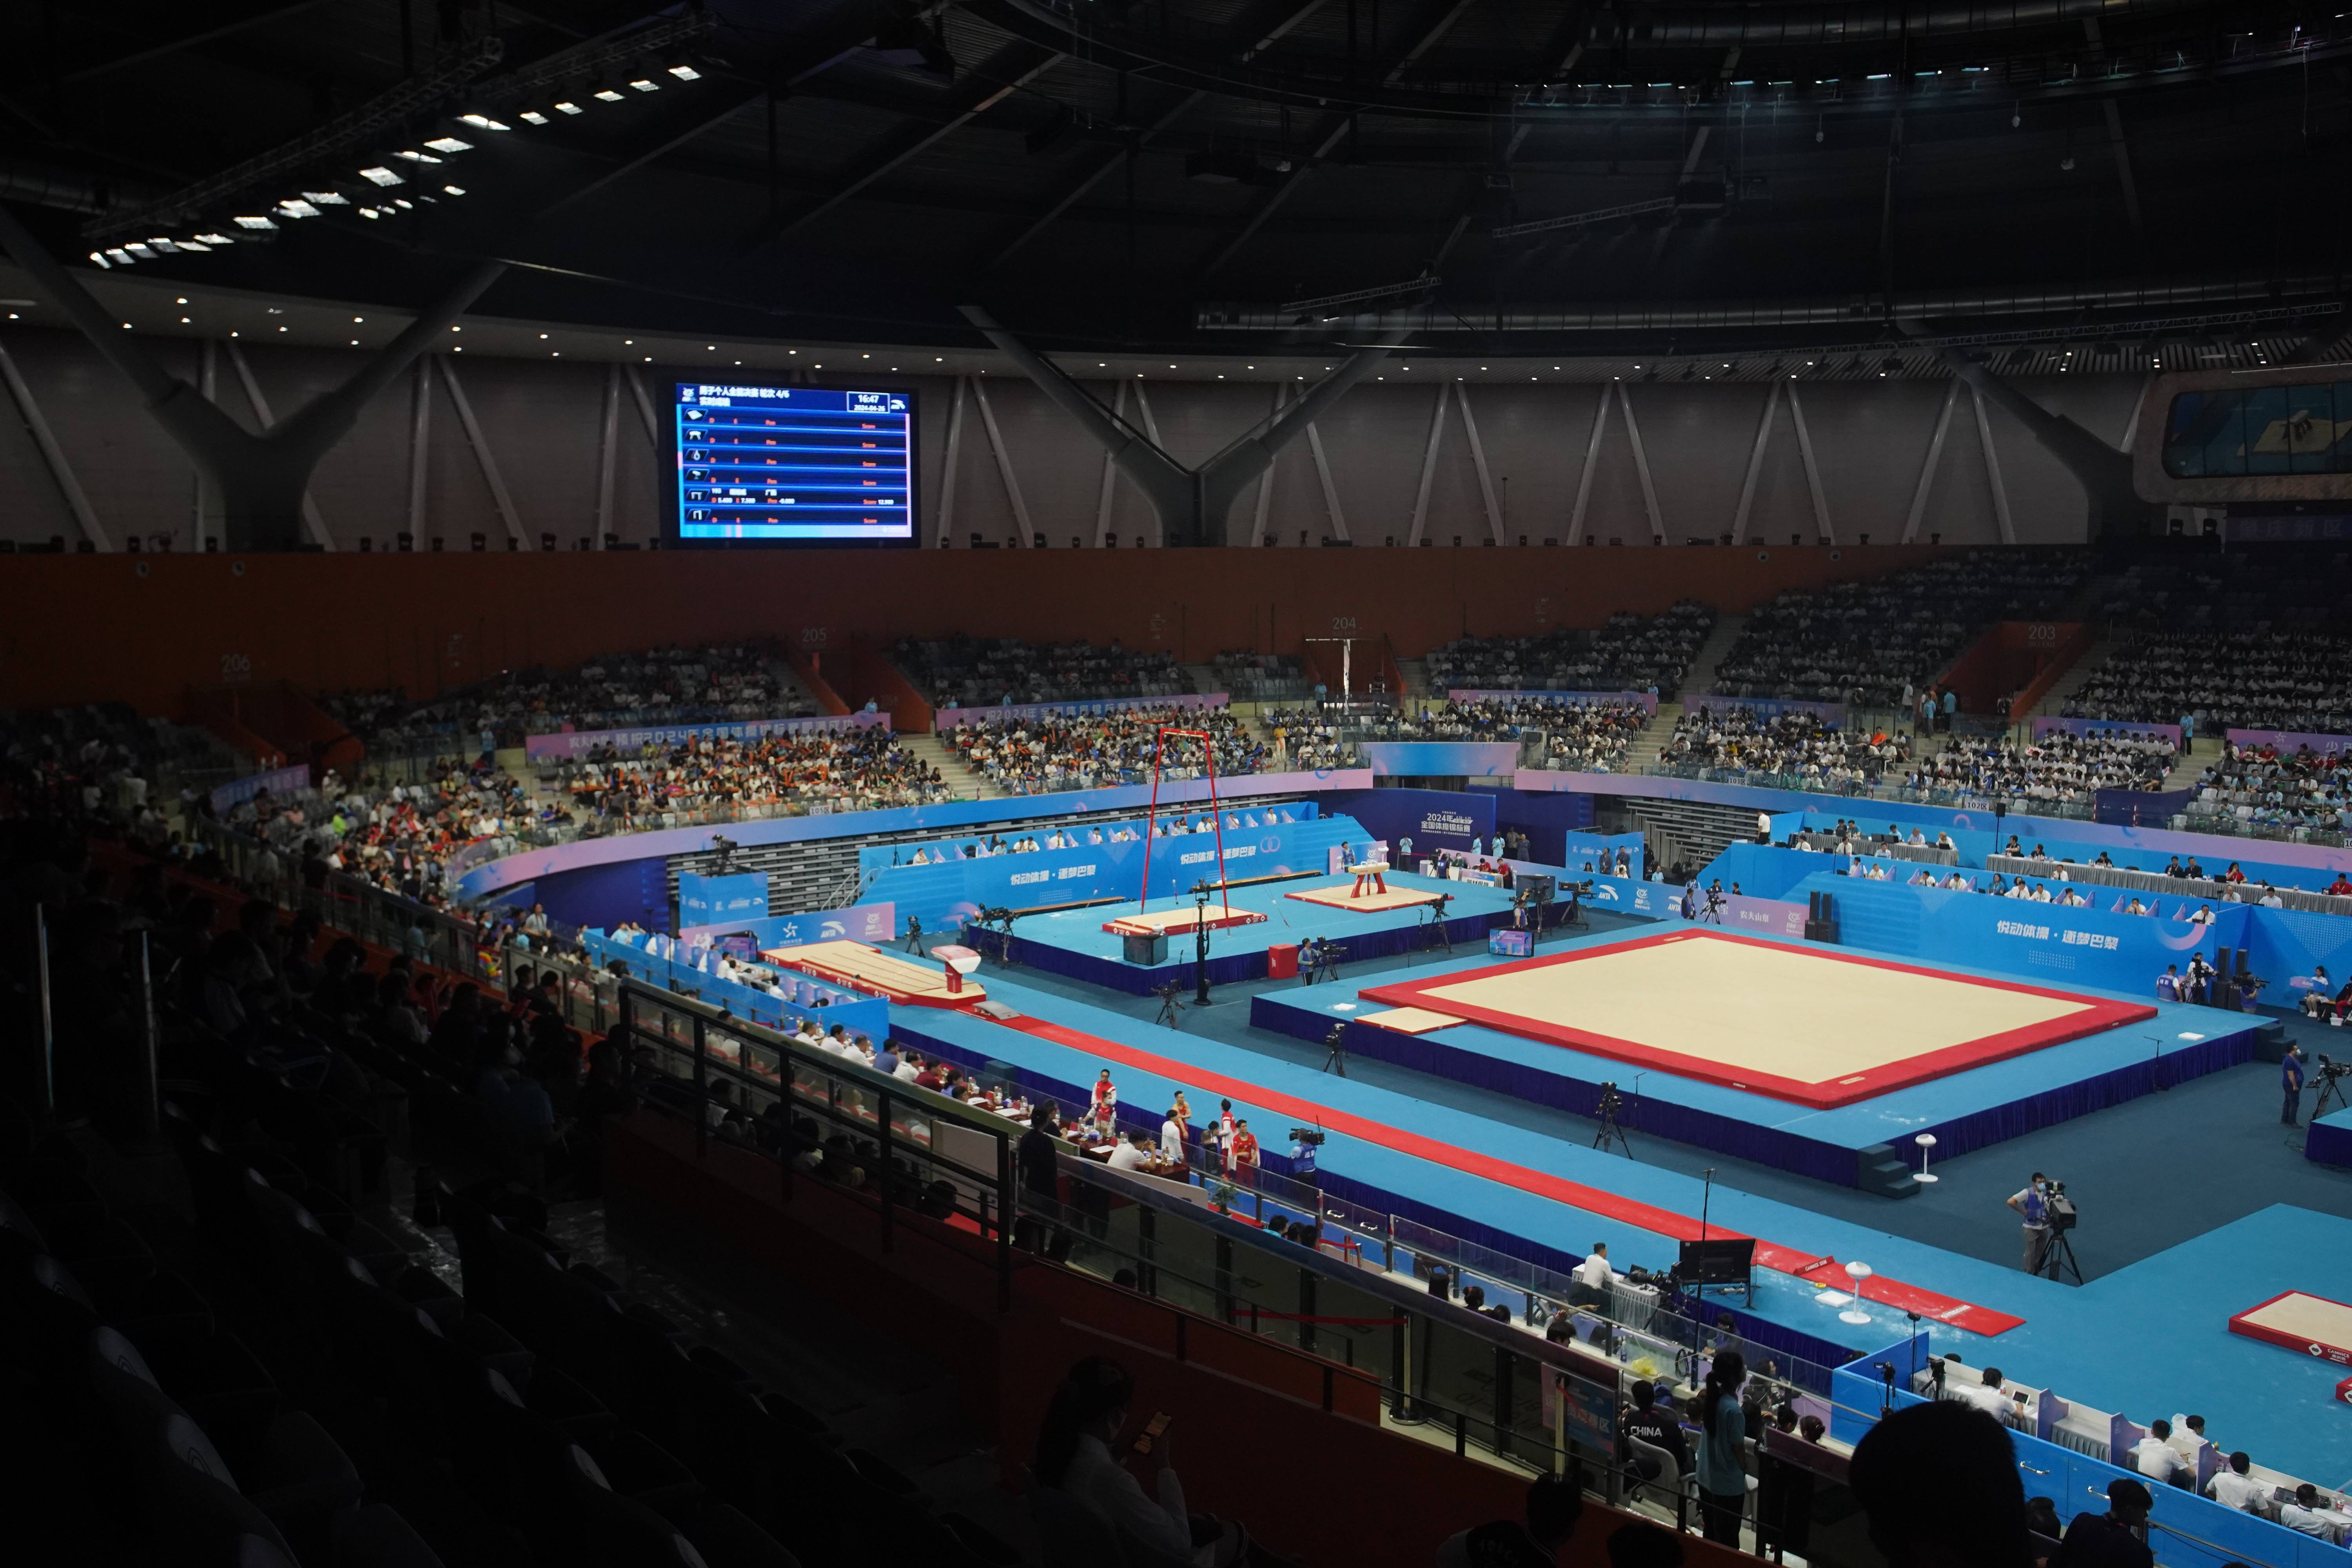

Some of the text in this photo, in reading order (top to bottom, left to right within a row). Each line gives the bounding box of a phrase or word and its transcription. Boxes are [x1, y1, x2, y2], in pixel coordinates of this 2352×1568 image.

[858, 394, 879, 403] 16:47
[1333, 617, 1356, 629] 204
[802, 628, 827, 642] 205
[2029, 625, 2055, 640] 203
[1427, 813, 1453, 822] 2024年
[1421, 821, 1470, 833] 全国体操锦标赛
[1599, 892, 1611, 900] ANTA
[1668, 903, 1681, 912] ANTA
[1740, 910, 1769, 922] 农夫山泉
[1997, 920, 2119, 951] 悦动体操·逐梦巴黎
[2327, 1348, 2350, 1358] CANNICE
[1630, 1425, 1662, 1438] CHINA
